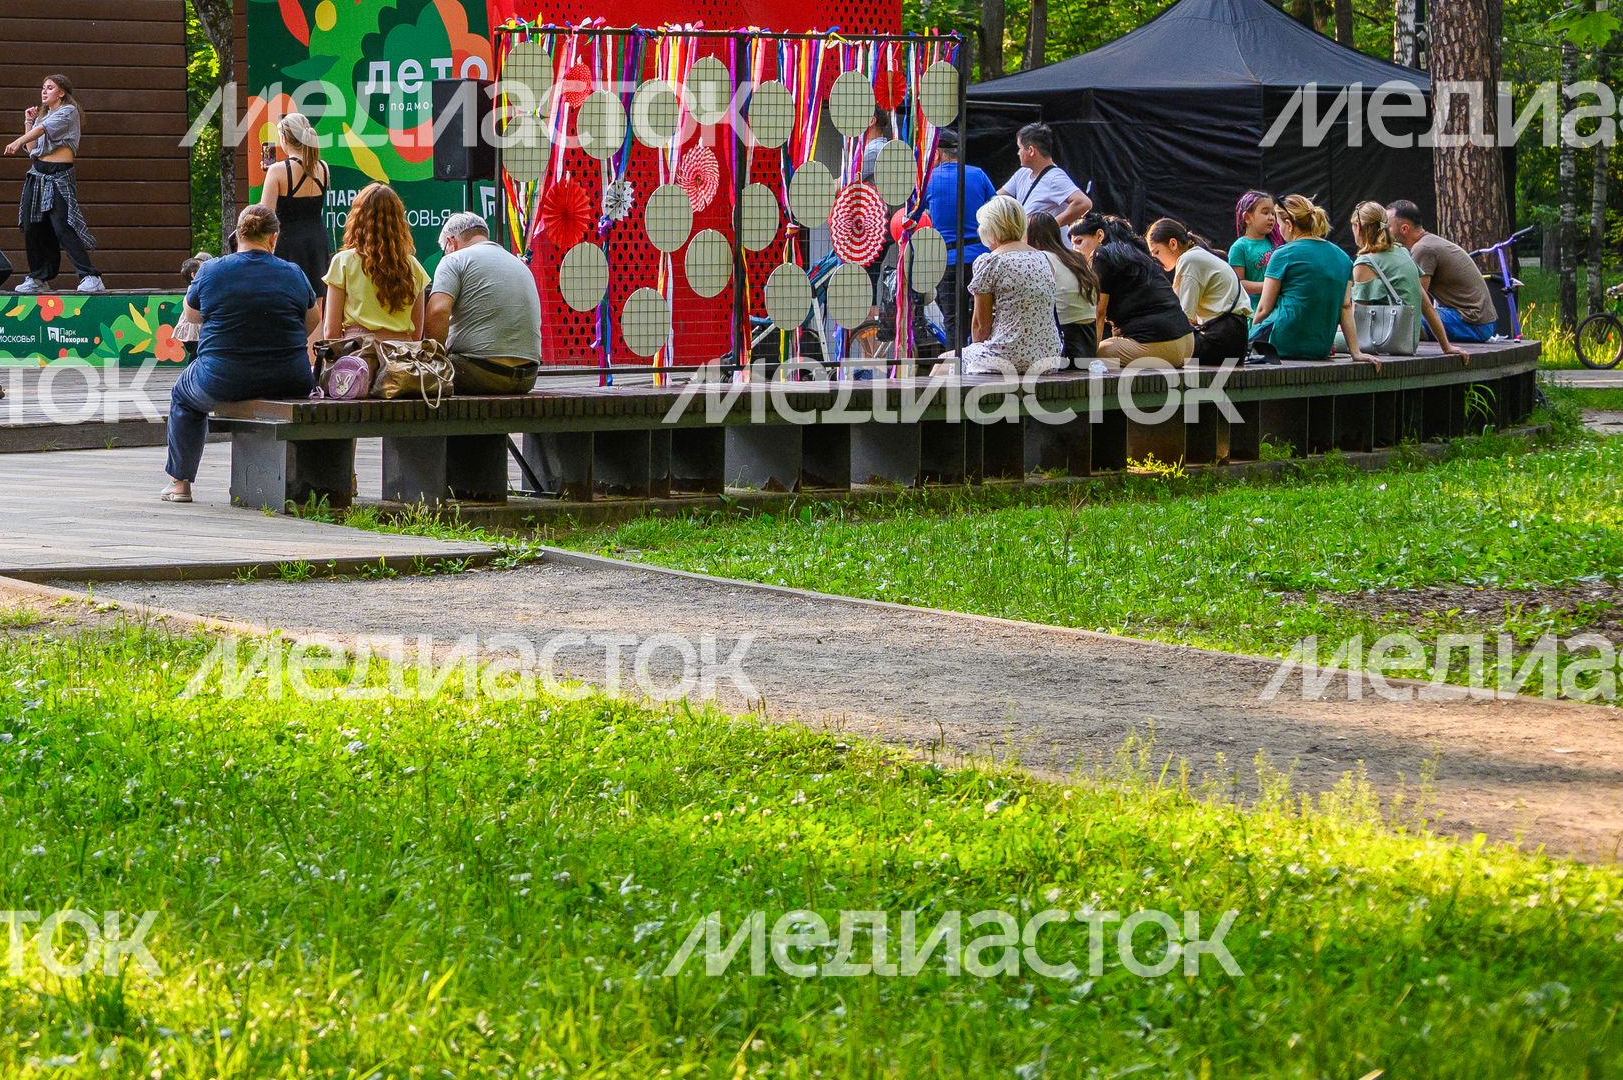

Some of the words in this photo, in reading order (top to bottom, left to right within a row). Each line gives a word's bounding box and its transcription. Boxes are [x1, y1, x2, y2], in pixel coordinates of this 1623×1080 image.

[391, 102, 433, 111] подмо
[327, 190, 360, 206] ПАР
[60, 328, 76, 336] Парк
